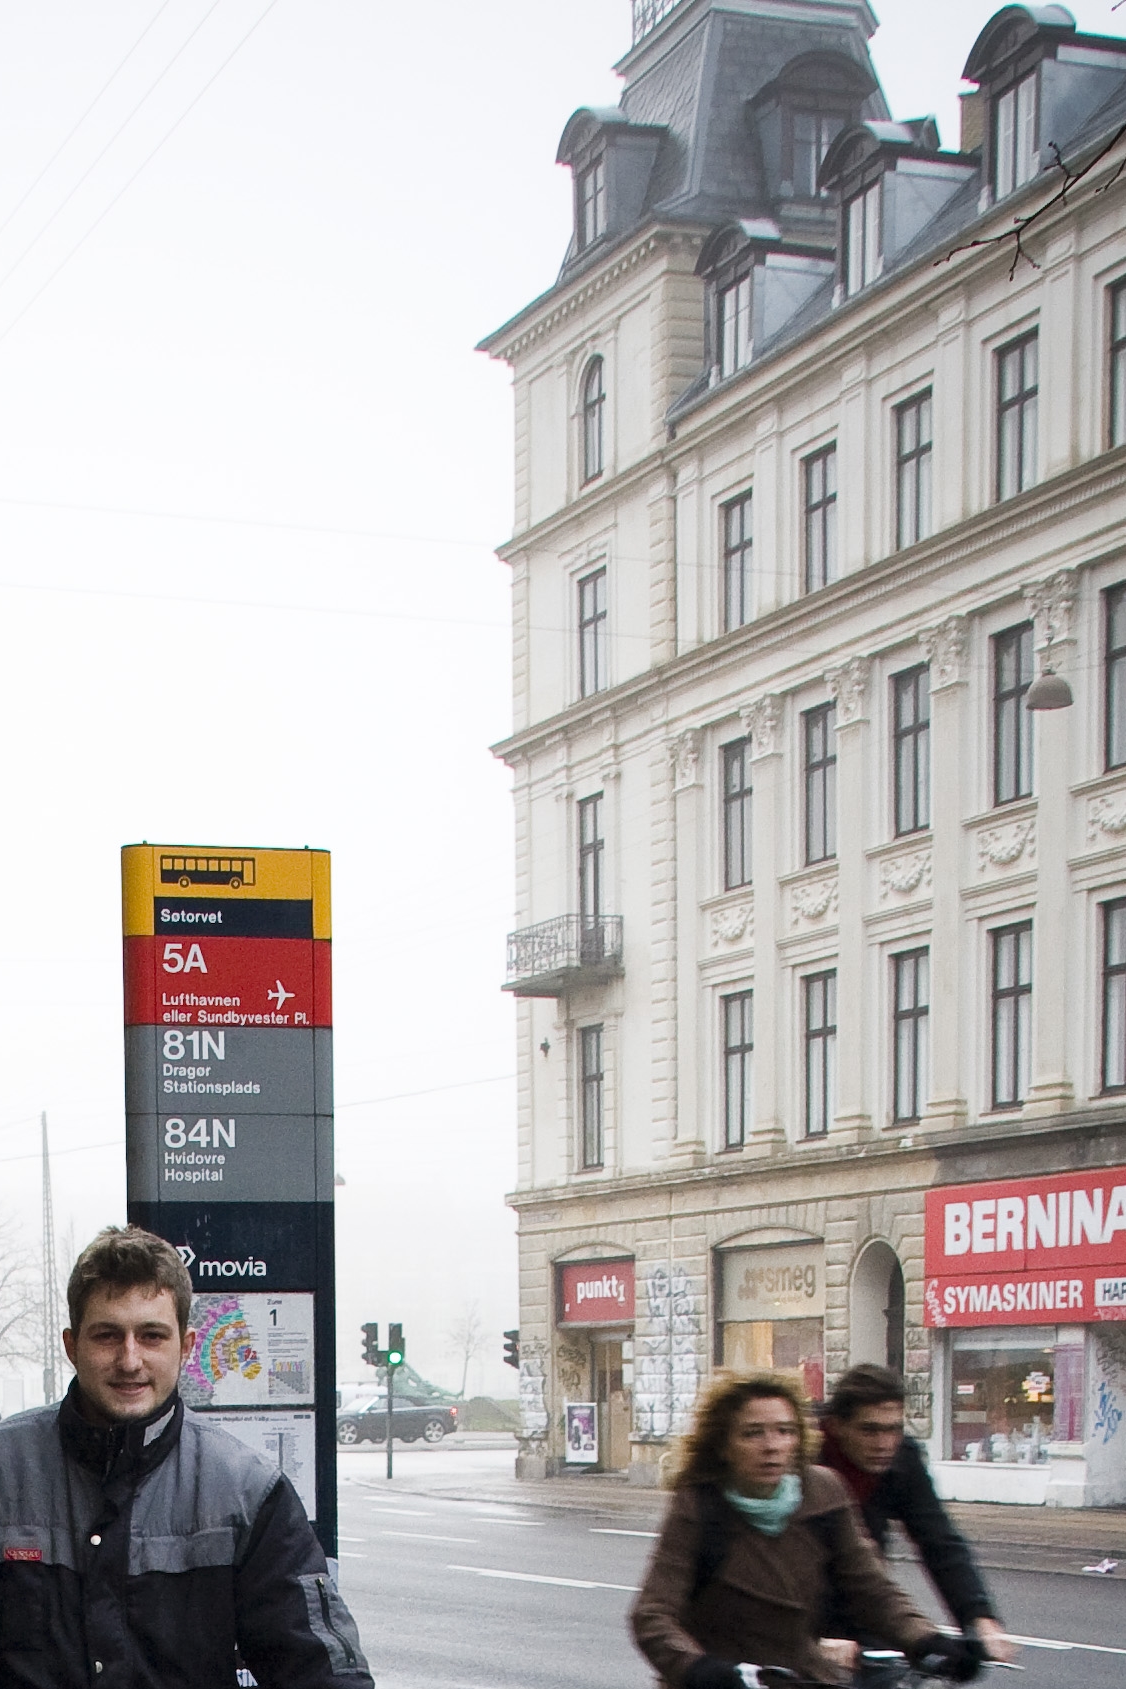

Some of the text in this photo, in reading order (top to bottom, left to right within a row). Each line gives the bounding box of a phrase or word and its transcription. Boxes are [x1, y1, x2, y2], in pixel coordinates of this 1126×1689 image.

[160, 908, 223, 924] Søtorvet
[162, 943, 208, 974] 5A
[162, 993, 240, 1007] Lufthavnen
[162, 1009, 310, 1026] eller Sundbyvester Pl.
[162, 1030, 225, 1060] 81N
[162, 1063, 211, 1079] Dragør
[163, 1080, 260, 1095] Stationsplads
[164, 1118, 236, 1148] 84N
[164, 1152, 225, 1166] Hvidovre
[164, 1168, 223, 1183] Hospital
[943, 1185, 1126, 1257] BERNINA
[199, 1256, 267, 1277] movia
[764, 1264, 816, 1298] smeg
[943, 1279, 1084, 1315] SYMASKINER
[269, 1308, 278, 1326] 1
